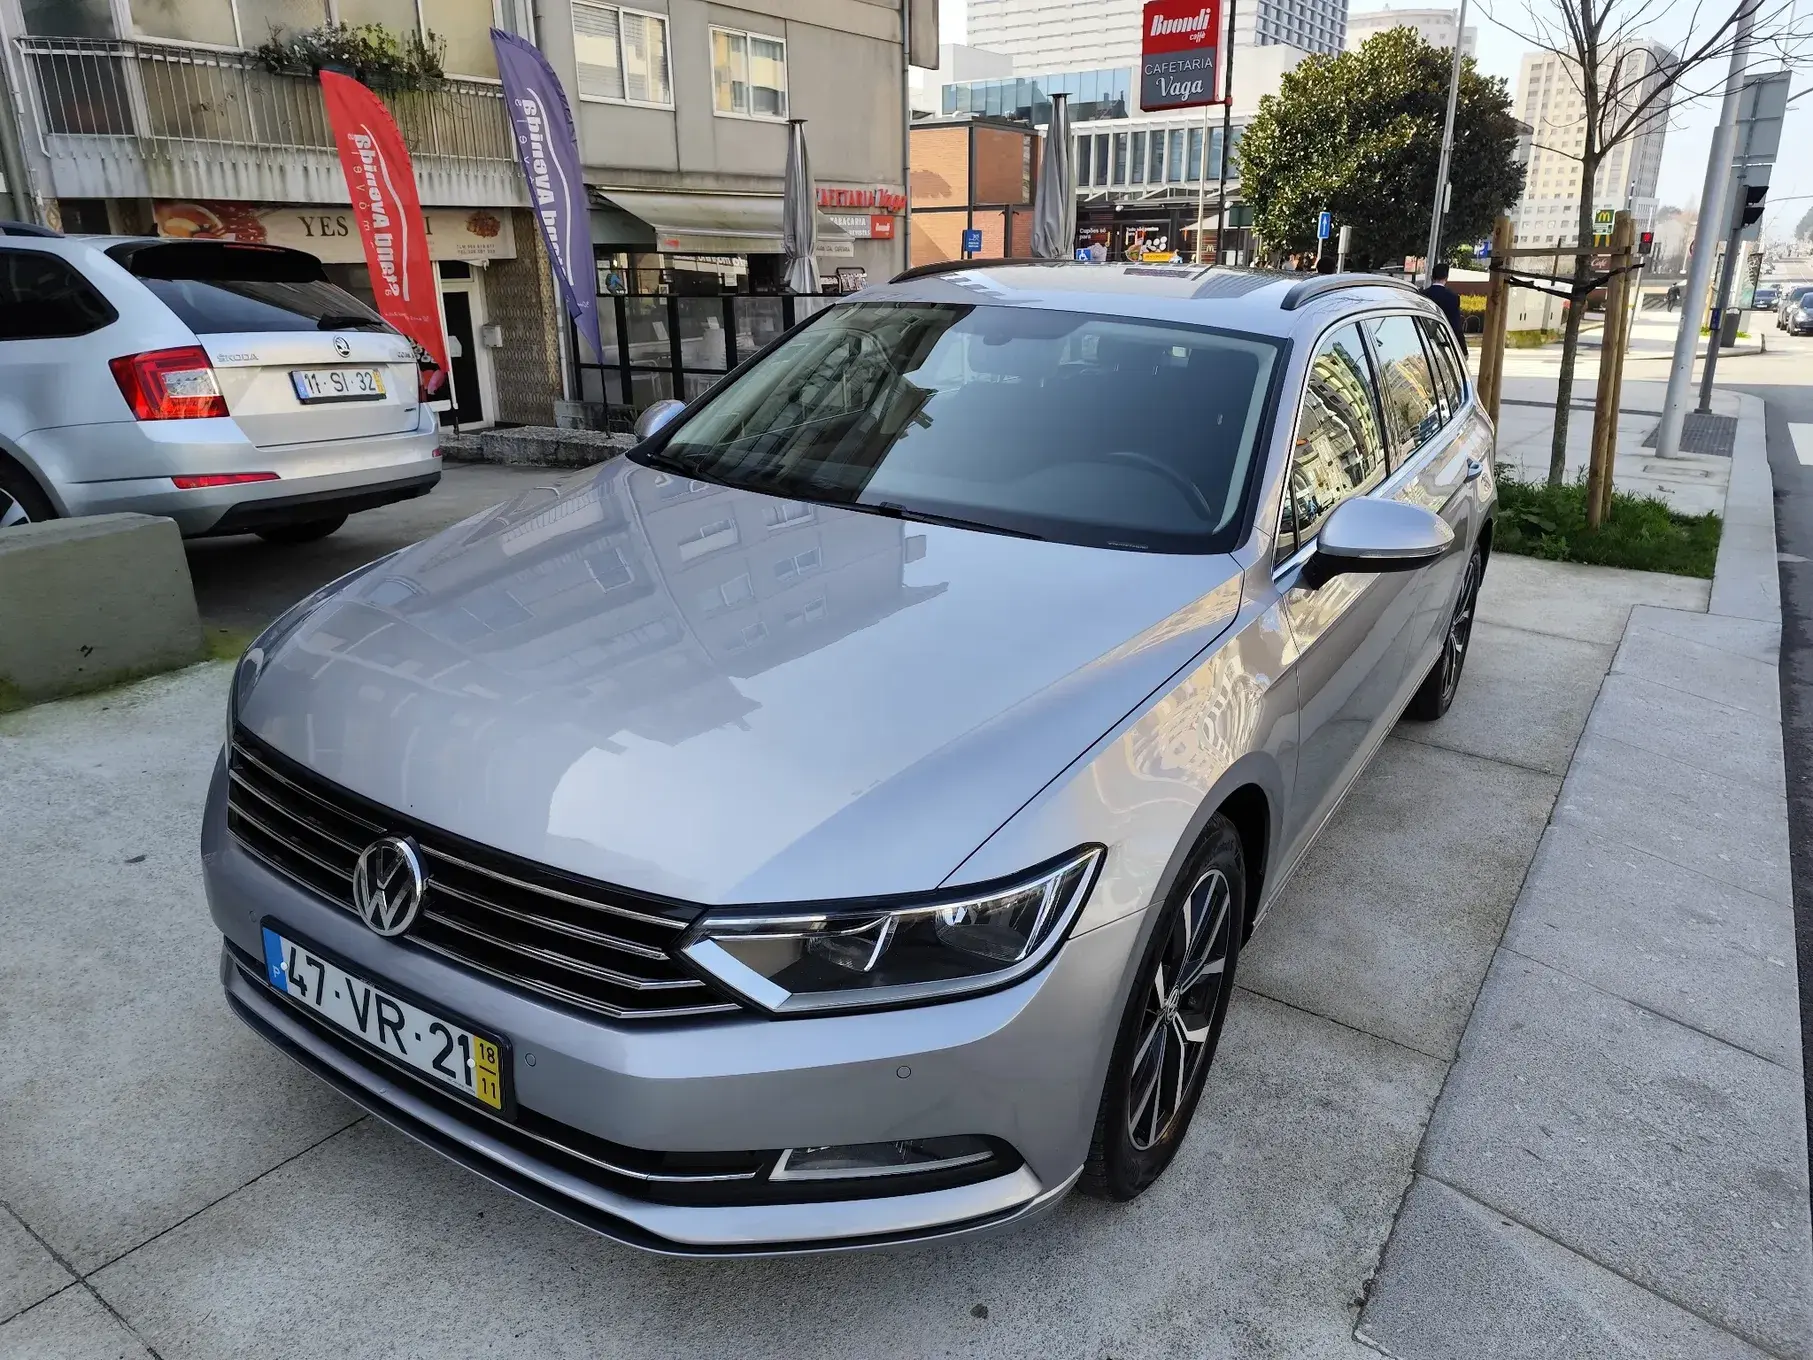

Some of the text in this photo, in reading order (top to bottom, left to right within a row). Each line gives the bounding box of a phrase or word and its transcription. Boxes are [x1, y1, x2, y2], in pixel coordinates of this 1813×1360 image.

[1150, 8, 1211, 36] Buondi
[1144, 57, 1213, 75] CAFETARIA
[1155, 76, 1204, 101] Vaga
[297, 215, 349, 237] YES
[1591, 257, 1608, 269] Café
[272, 964, 280, 978] P
[479, 1042, 496, 1064] 18
[481, 1077, 497, 1100] 11
